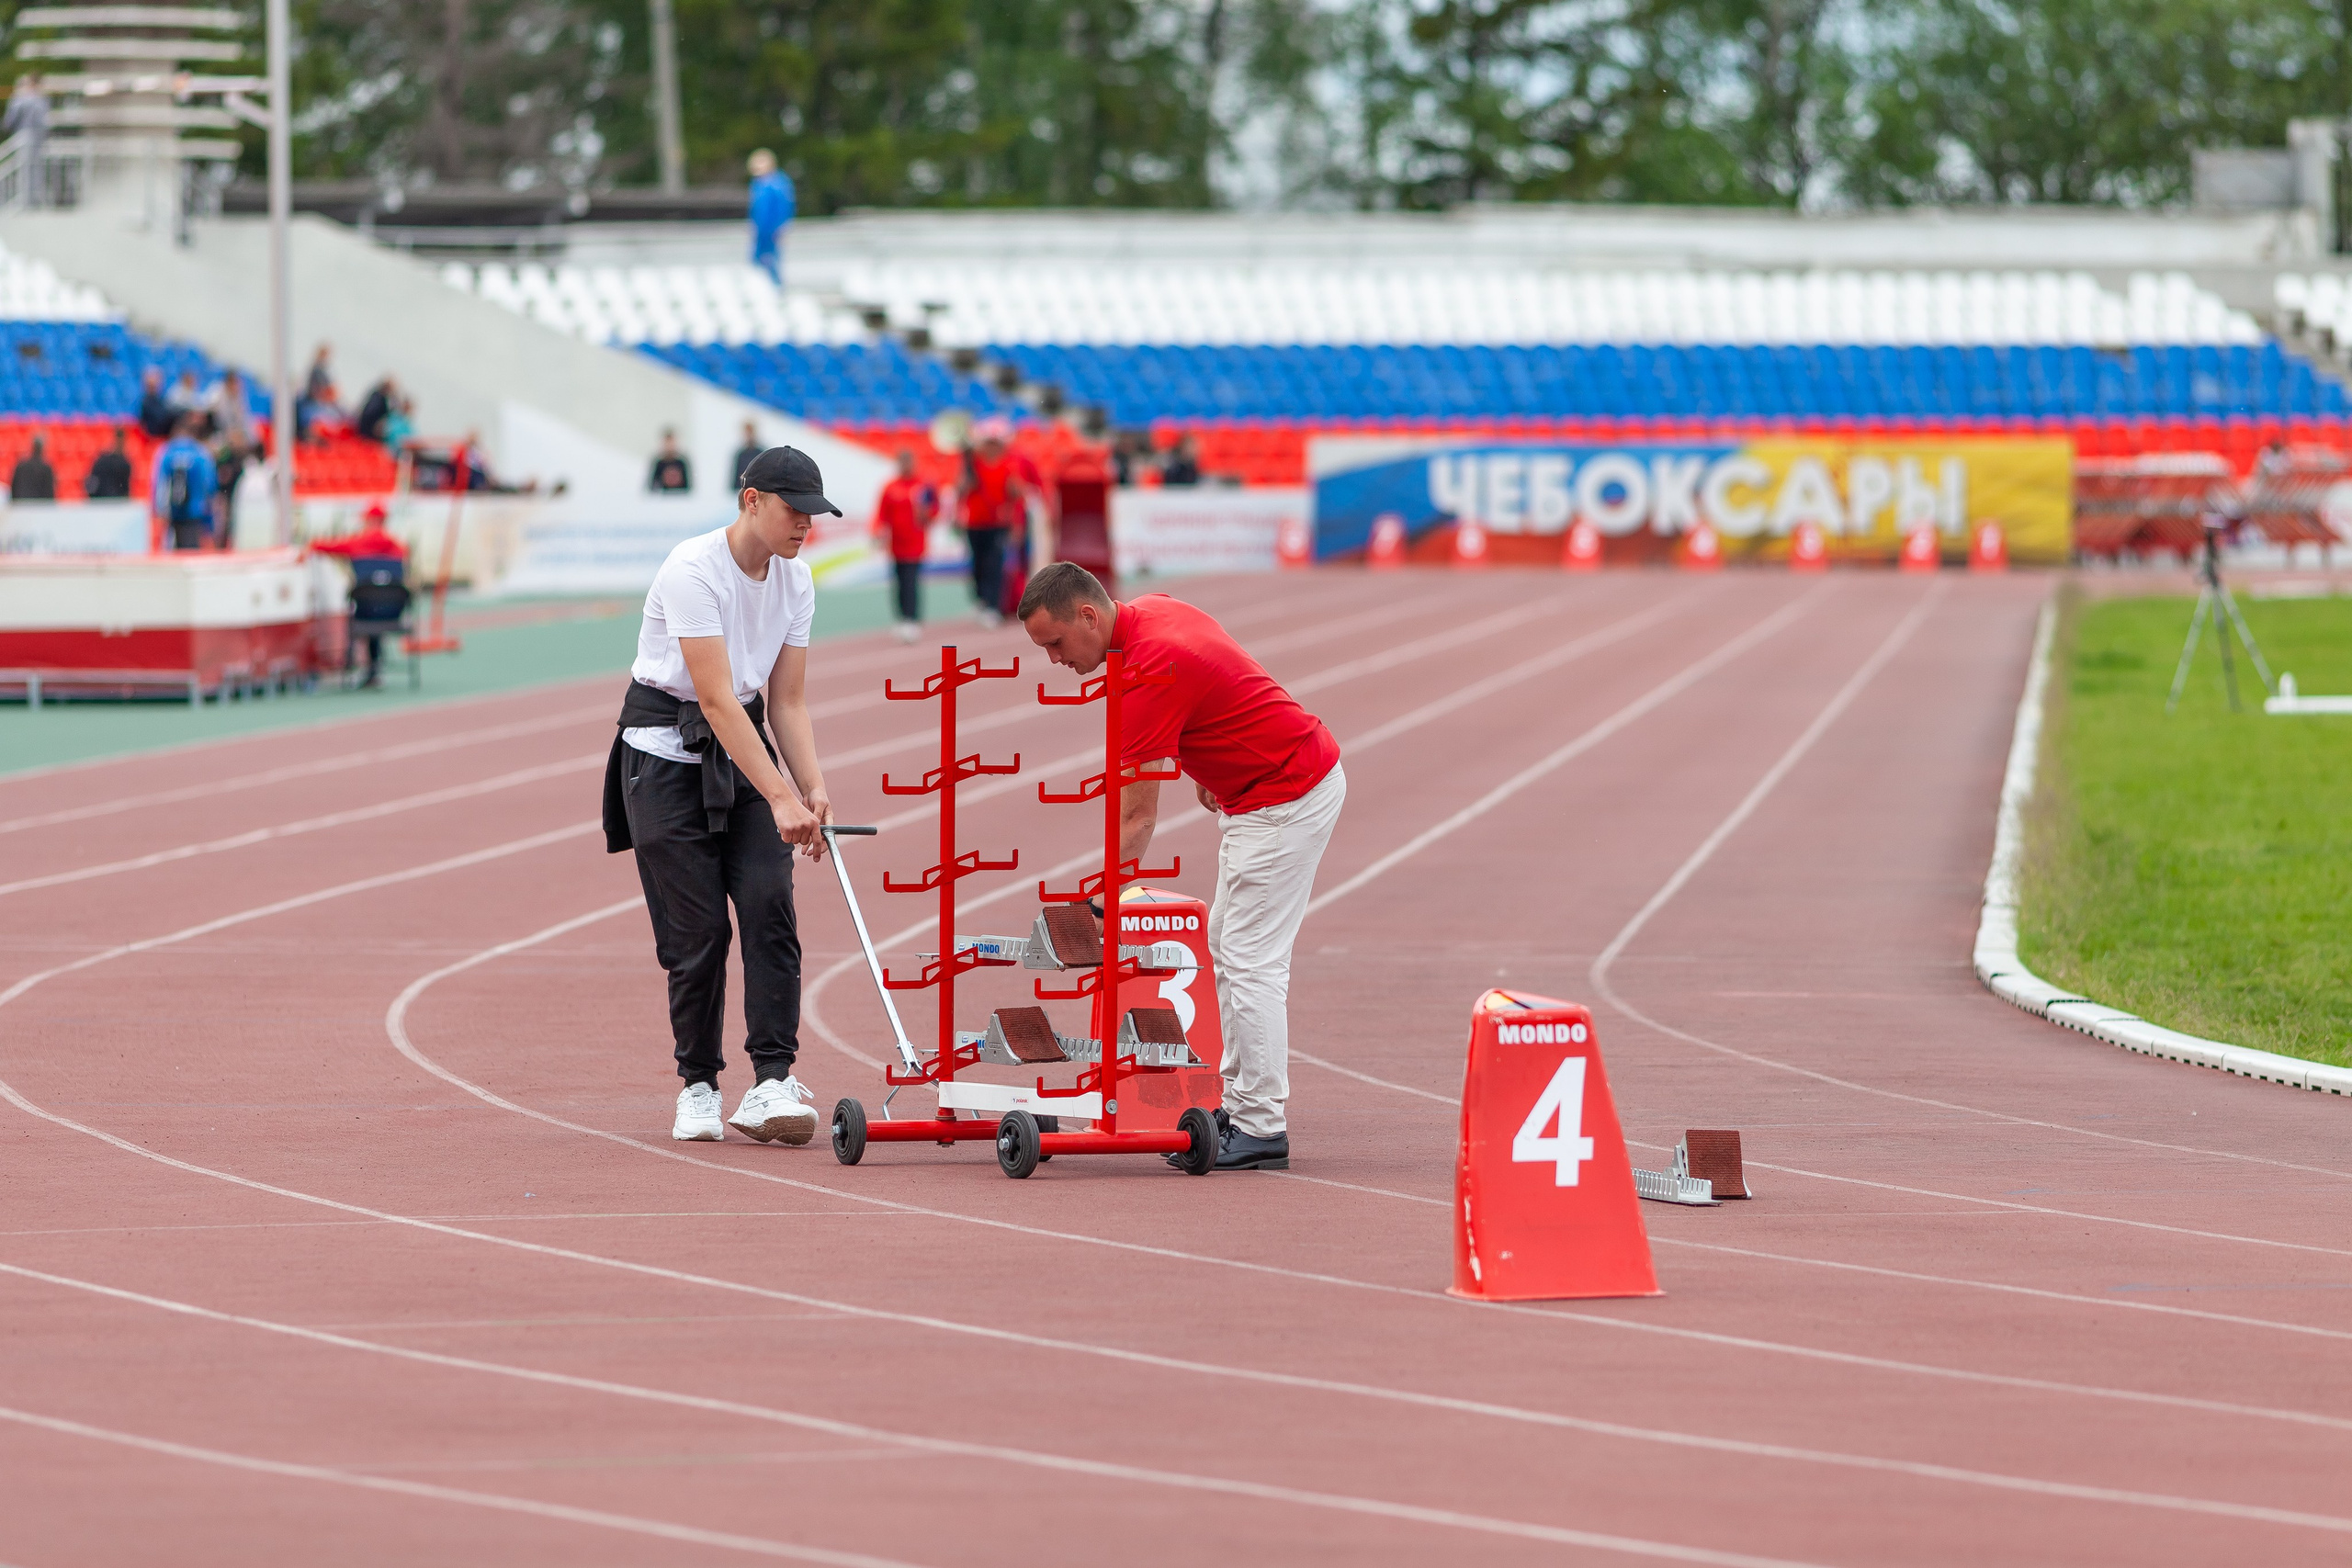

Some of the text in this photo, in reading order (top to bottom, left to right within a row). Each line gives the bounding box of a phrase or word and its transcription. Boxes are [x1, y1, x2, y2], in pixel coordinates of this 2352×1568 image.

[1429, 453, 1966, 536] ЧЕБОКСАРЫ
[1121, 916, 1199, 931] MONDO
[1150, 940, 1198, 1034] 3
[1499, 1023, 1587, 1043] MONDO
[1512, 1056, 1594, 1187] 4
